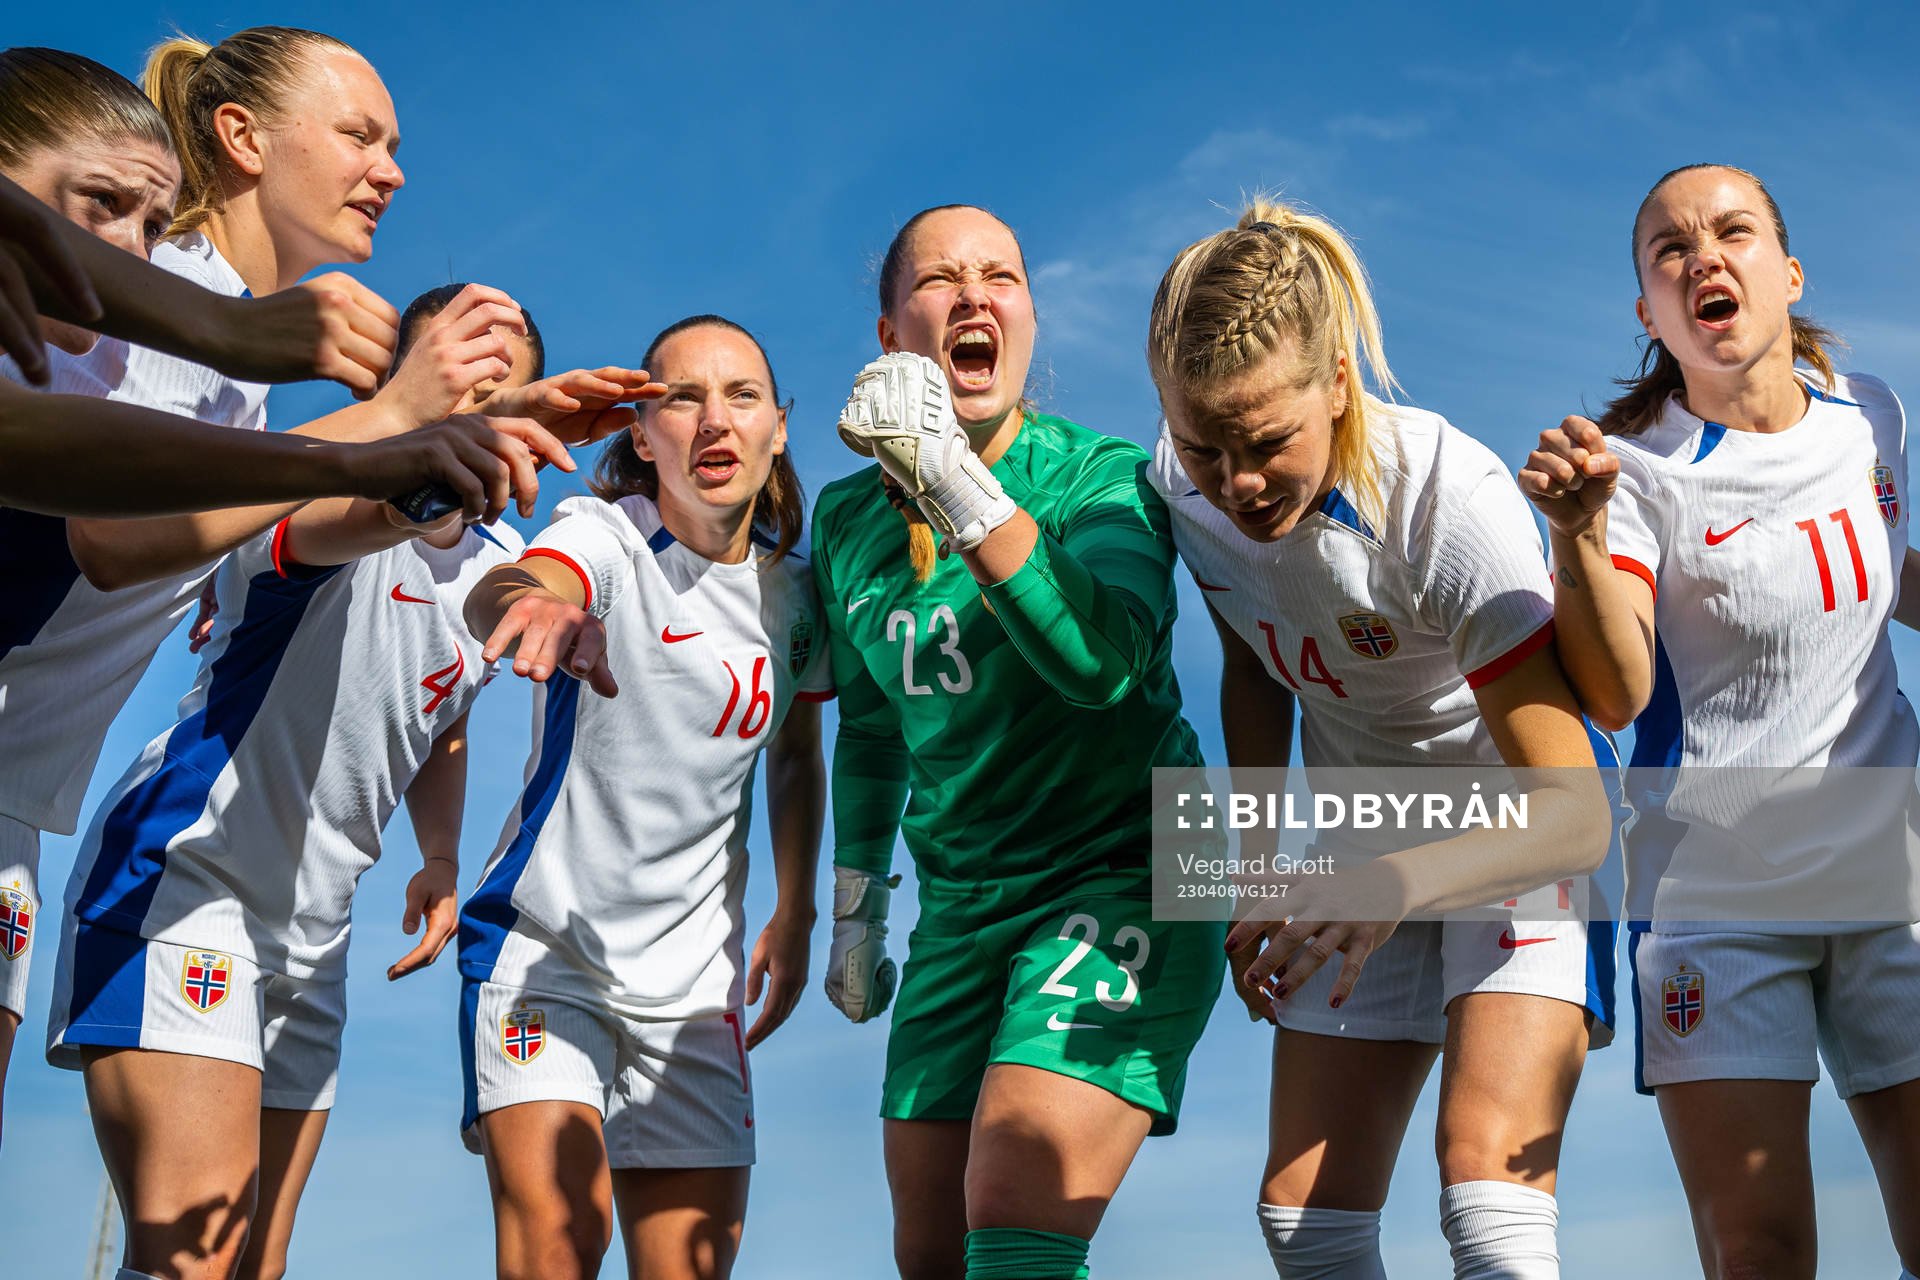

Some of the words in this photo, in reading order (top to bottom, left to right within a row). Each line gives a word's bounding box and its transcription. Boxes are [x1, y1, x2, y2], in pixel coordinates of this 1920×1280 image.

[1795, 508, 1868, 613] 11
[420, 640, 465, 714] 4
[887, 604, 973, 695] 23
[1257, 619, 1349, 699] 14
[711, 656, 771, 739] 16
[1038, 913, 1150, 1012] 23
